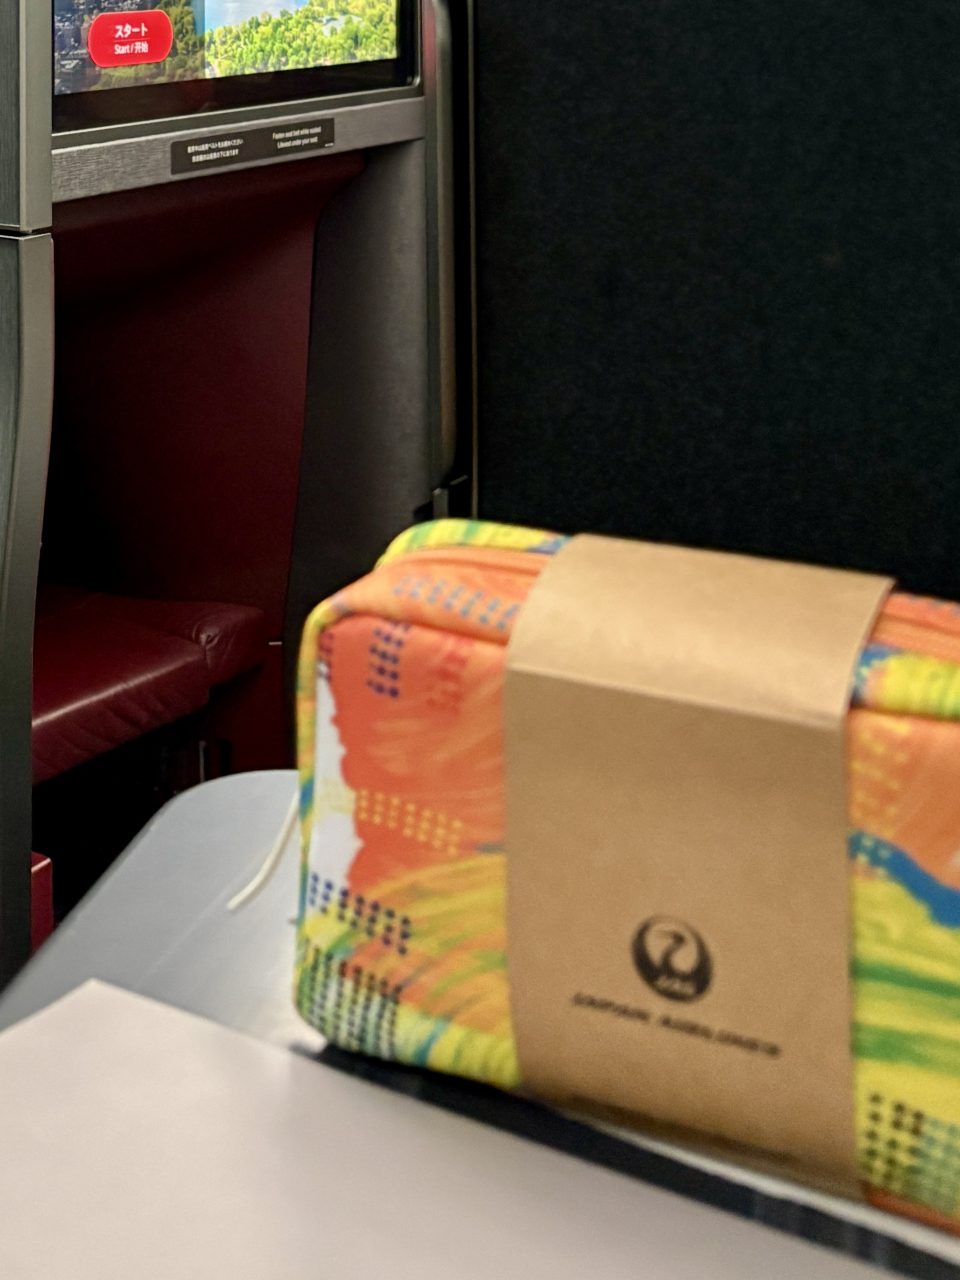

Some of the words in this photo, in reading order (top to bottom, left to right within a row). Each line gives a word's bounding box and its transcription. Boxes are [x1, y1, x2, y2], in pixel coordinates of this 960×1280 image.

[114, 22, 149, 38] スタート
[114, 43, 130, 55] Start
